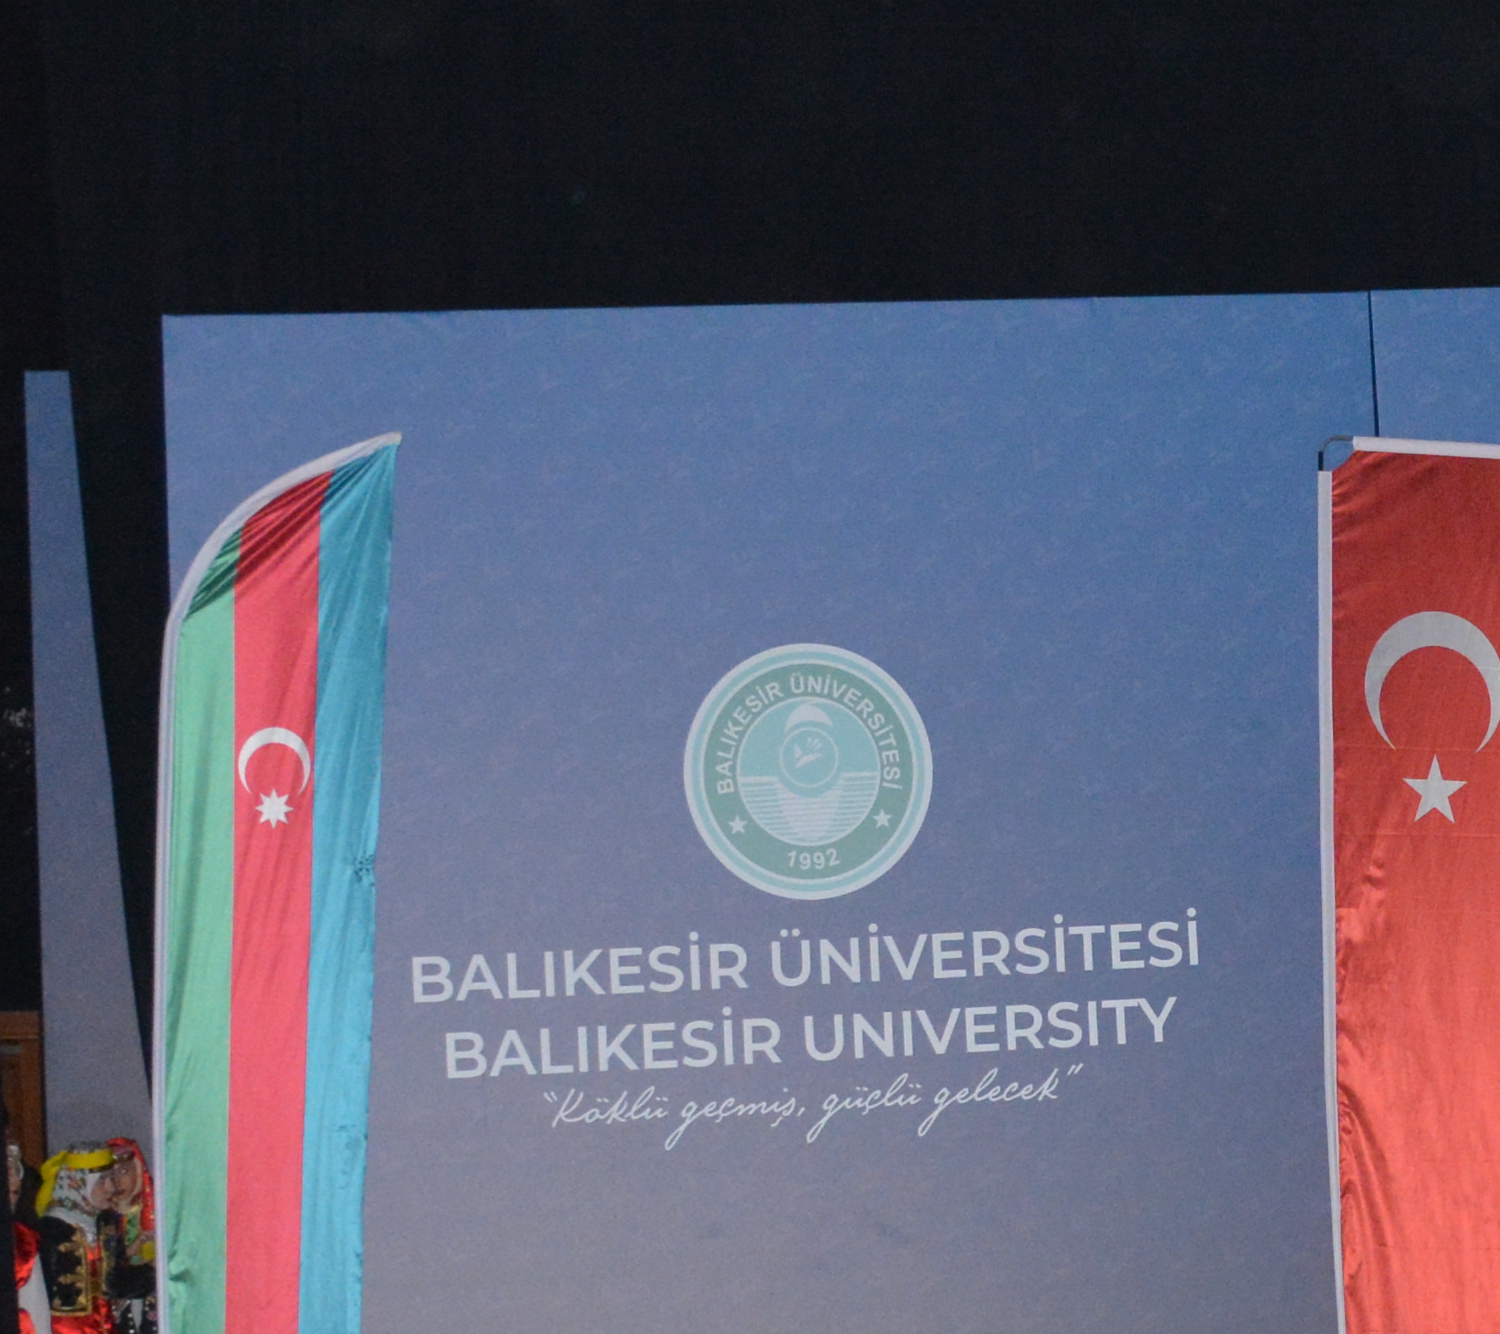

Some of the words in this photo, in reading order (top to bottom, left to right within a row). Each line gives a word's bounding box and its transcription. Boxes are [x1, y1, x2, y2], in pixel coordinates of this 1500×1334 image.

[787, 847, 840, 870] 1992
[412, 931, 748, 1003] BALIKESİR
[770, 907, 1199, 987] ÜNİVERSİTESİ
[445, 1006, 781, 1079] BALIKESİR
[803, 996, 1178, 1062] UNIVERSITY
[806, 1072, 922, 1144] güçlü
